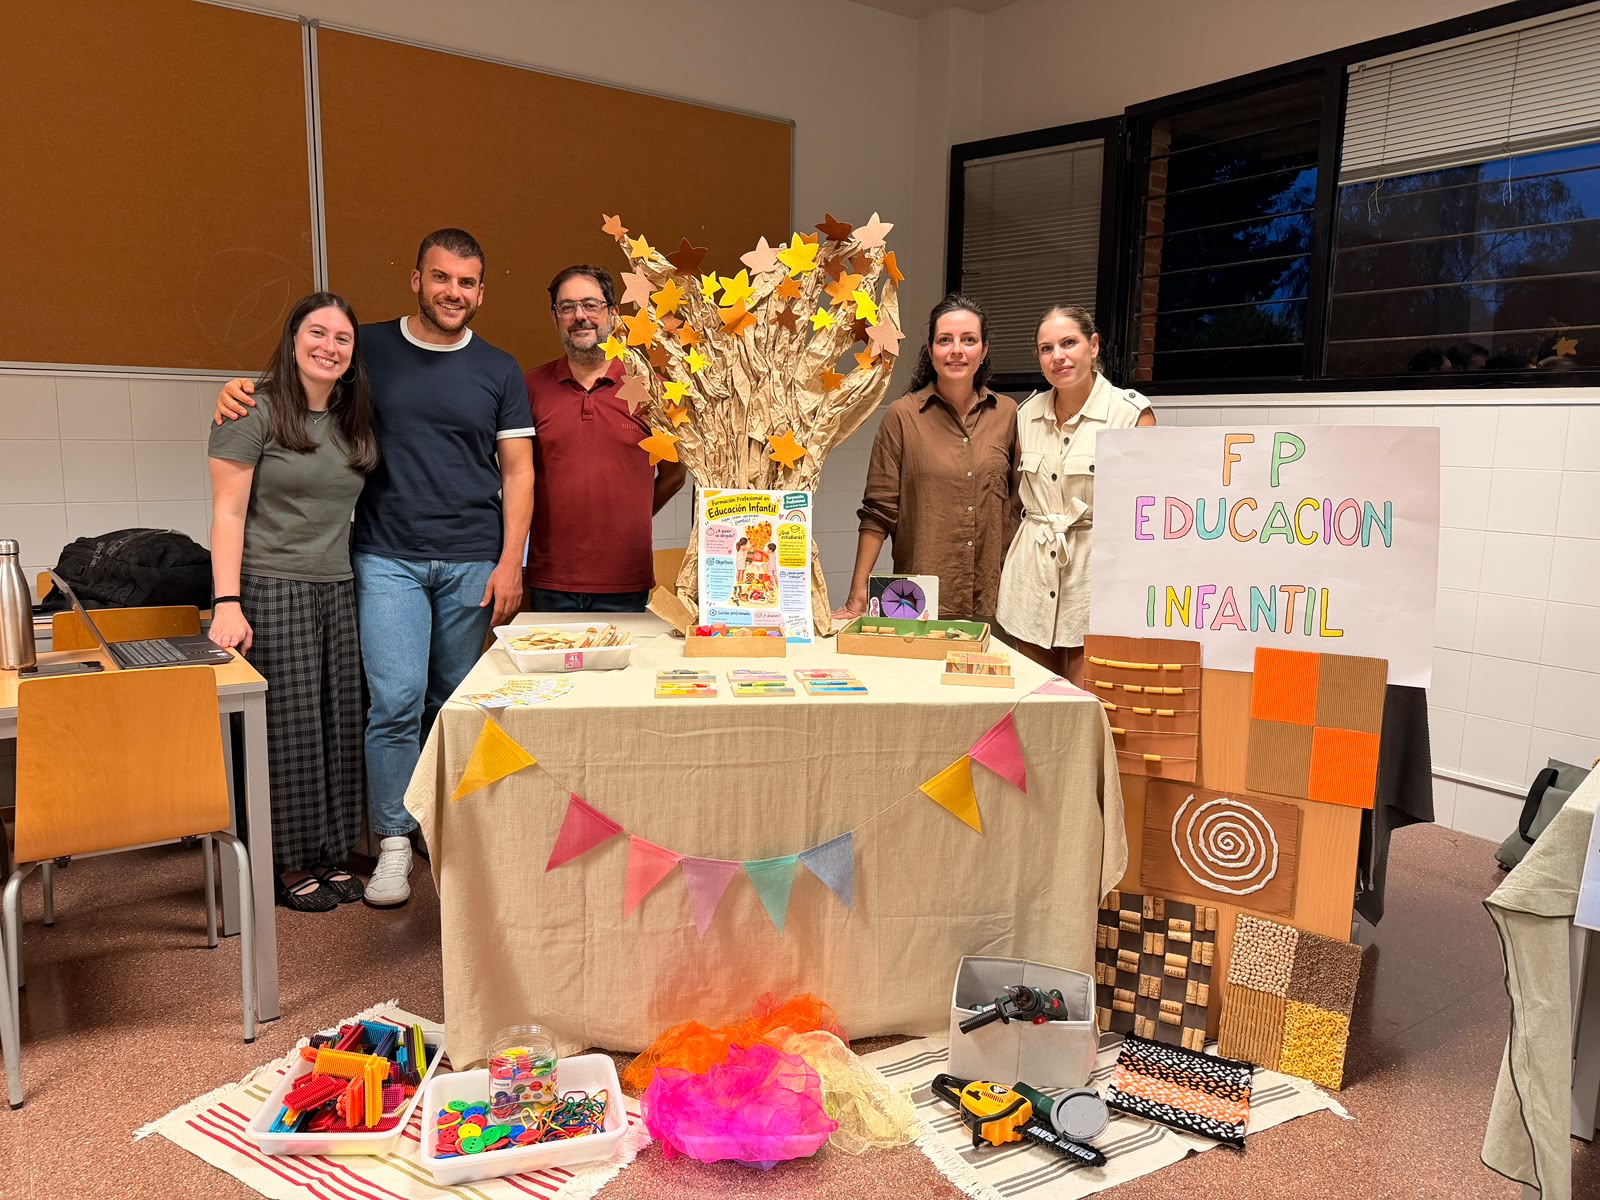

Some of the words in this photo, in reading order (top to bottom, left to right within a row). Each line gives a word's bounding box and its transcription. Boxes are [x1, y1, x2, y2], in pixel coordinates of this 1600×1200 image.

[1222, 432, 1255, 487] F
[1270, 431, 1306, 488] P
[707, 503, 747, 519] Educación
[748, 502, 777, 513] Infantil
[711, 497, 737, 507] Formación
[736, 495, 763, 503] Profesional
[1134, 496, 1393, 548] EDUCACION
[1146, 584, 1344, 638] INFANTIL
[1026, 1125, 1058, 1142] SAW
[1054, 1140, 1097, 1161] CHAIN
